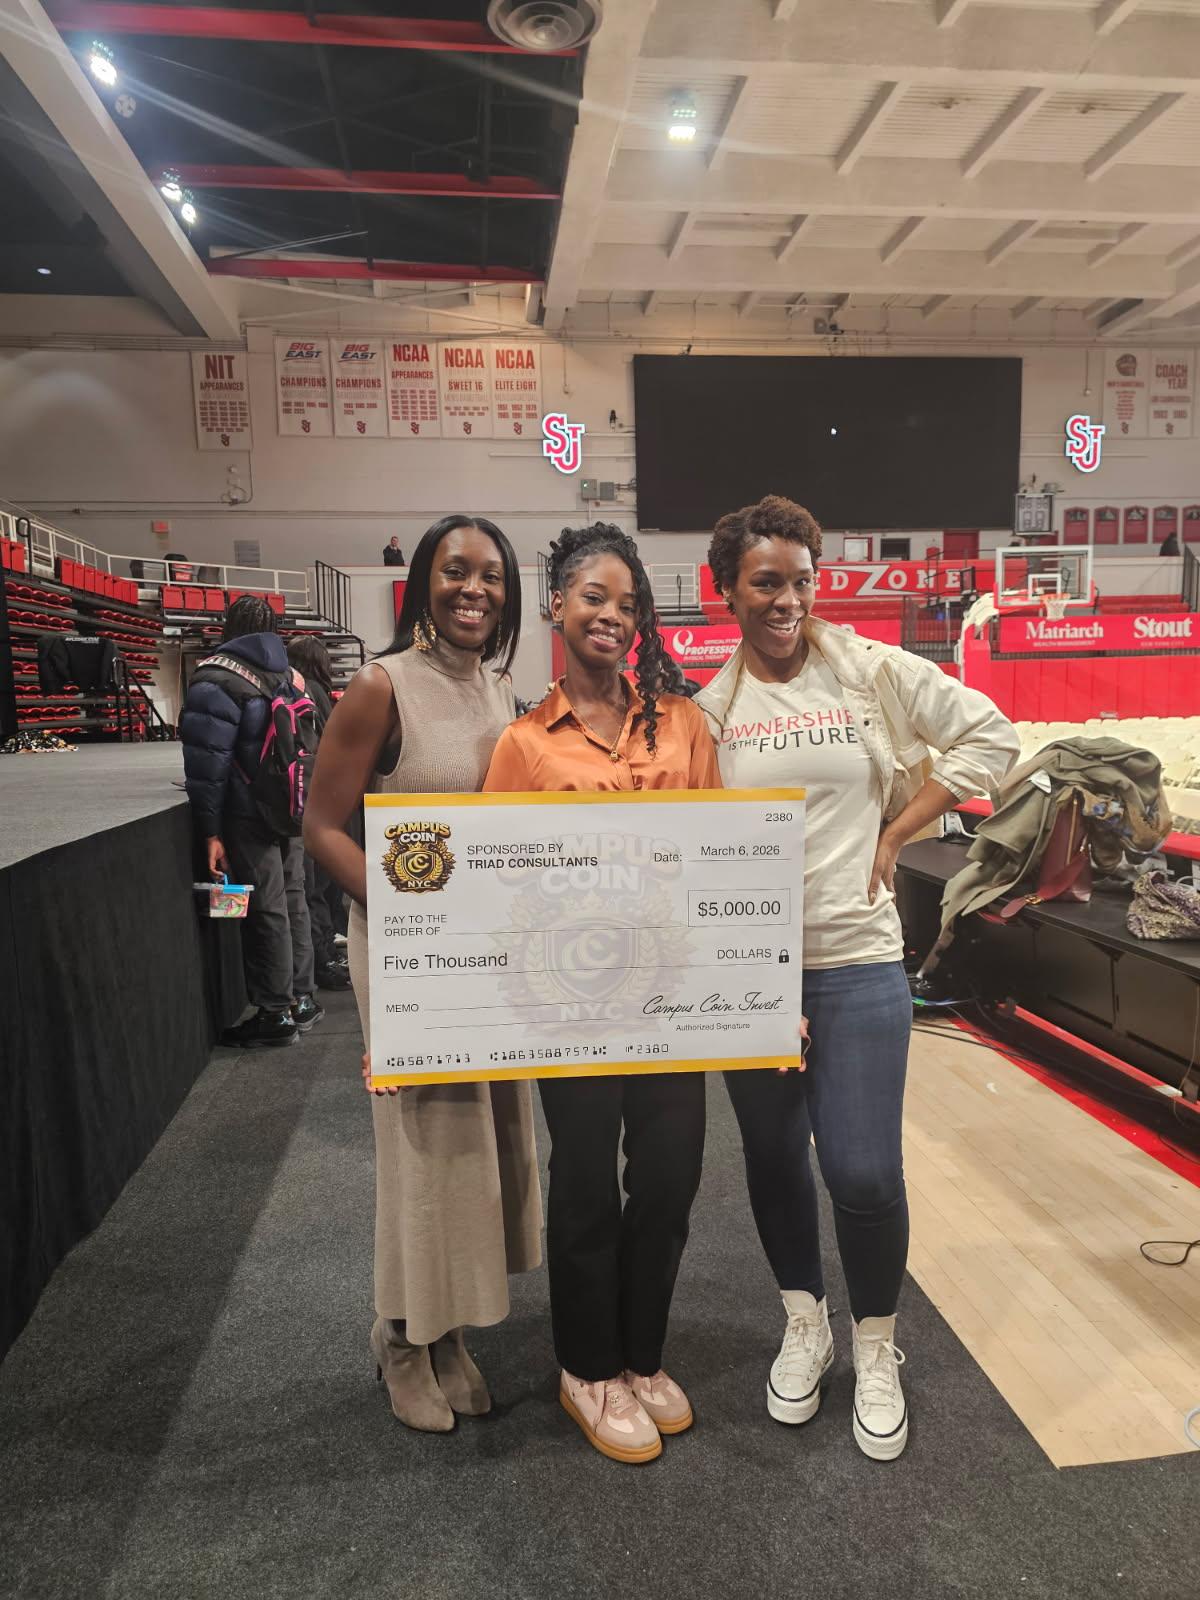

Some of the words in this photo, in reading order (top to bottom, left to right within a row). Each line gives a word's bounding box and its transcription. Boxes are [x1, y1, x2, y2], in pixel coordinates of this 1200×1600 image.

[289, 342, 315, 350] BIG
[344, 344, 370, 352] BIG
[393, 344, 430, 362] NCAA
[444, 348, 485, 368] NCAA
[495, 349, 535, 369] NCAA
[205, 355, 235, 379] NIT
[1155, 364, 1188, 378] COACH
[392, 370, 433, 379] APPEARANCES
[200, 382, 244, 391] APPEARANCES
[281, 376, 326, 387] CHAMPIONS
[336, 378, 382, 388] CHAMPIONS
[448, 380, 472, 391] SWEET
[475, 381, 483, 391] 16
[495, 380, 514, 390] ELITE
[516, 381, 537, 391] EIGHT
[1168, 378, 1187, 389] YEAR
[1026, 621, 1104, 640] Matriarch
[1133, 616, 1193, 638] Stout
[728, 740, 737, 751] IS
[739, 738, 758, 748] THE
[759, 727, 858, 752] FUTURE
[765, 813, 793, 822] 2380
[384, 822, 451, 839] CAMPUS
[400, 832, 436, 843] COIN
[467, 844, 544, 855] SPONSORED
[548, 843, 564, 853] BY
[701, 846, 735, 856] March
[738, 846, 749, 857] 6,
[752, 845, 780, 855] 2026
[467, 859, 505, 869] TRIAD
[508, 857, 598, 868] CONSULTANTS
[654, 853, 682, 862] Date:
[540, 865, 641, 894] COIN
[698, 901, 781, 918] $5,000.00
[384, 916, 405, 925] PAY
[408, 915, 423, 924] TO
[426, 915, 447, 924] THE
[384, 928, 423, 937] ORDER
[426, 927, 441, 935] OF
[717, 949, 772, 959] DOLLARS
[384, 955, 419, 970] Five
[425, 953, 508, 968] Thousand
[386, 1004, 419, 1013] MEMO
[642, 995, 693, 1021] Campus
[700, 993, 734, 1012] Coin
[738, 992, 783, 1011] Invest
[676, 1023, 714, 1032] Authorized
[716, 1022, 750, 1032] Signature
